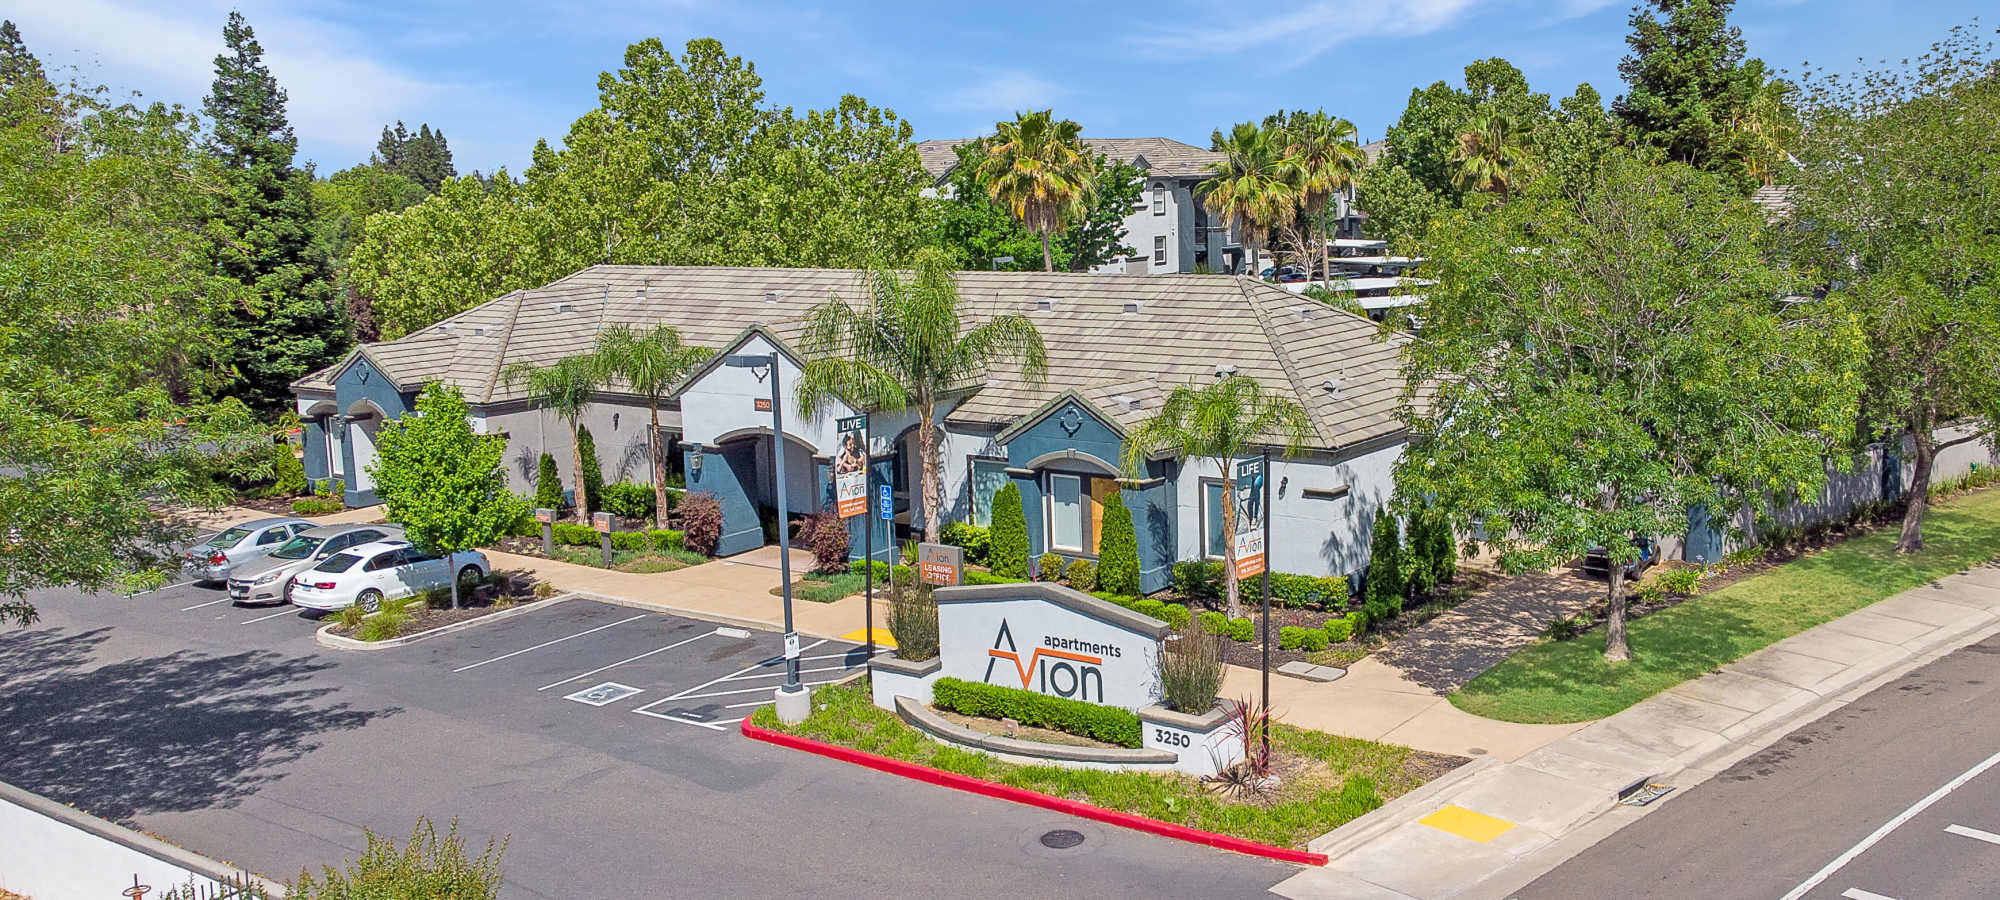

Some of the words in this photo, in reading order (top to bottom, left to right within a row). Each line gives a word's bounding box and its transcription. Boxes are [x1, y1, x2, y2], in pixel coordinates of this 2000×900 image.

[841, 418, 862, 431] LIVE
[1241, 462, 1260, 477] LIFE
[840, 482, 865, 498] Avion
[1237, 537, 1262, 557] Avion
[924, 563, 952, 574] LEASING
[927, 571, 951, 582] OFFICE
[1043, 634, 1122, 658] apartments
[984, 617, 1104, 703] Avion
[1155, 728, 1191, 748] 3250
